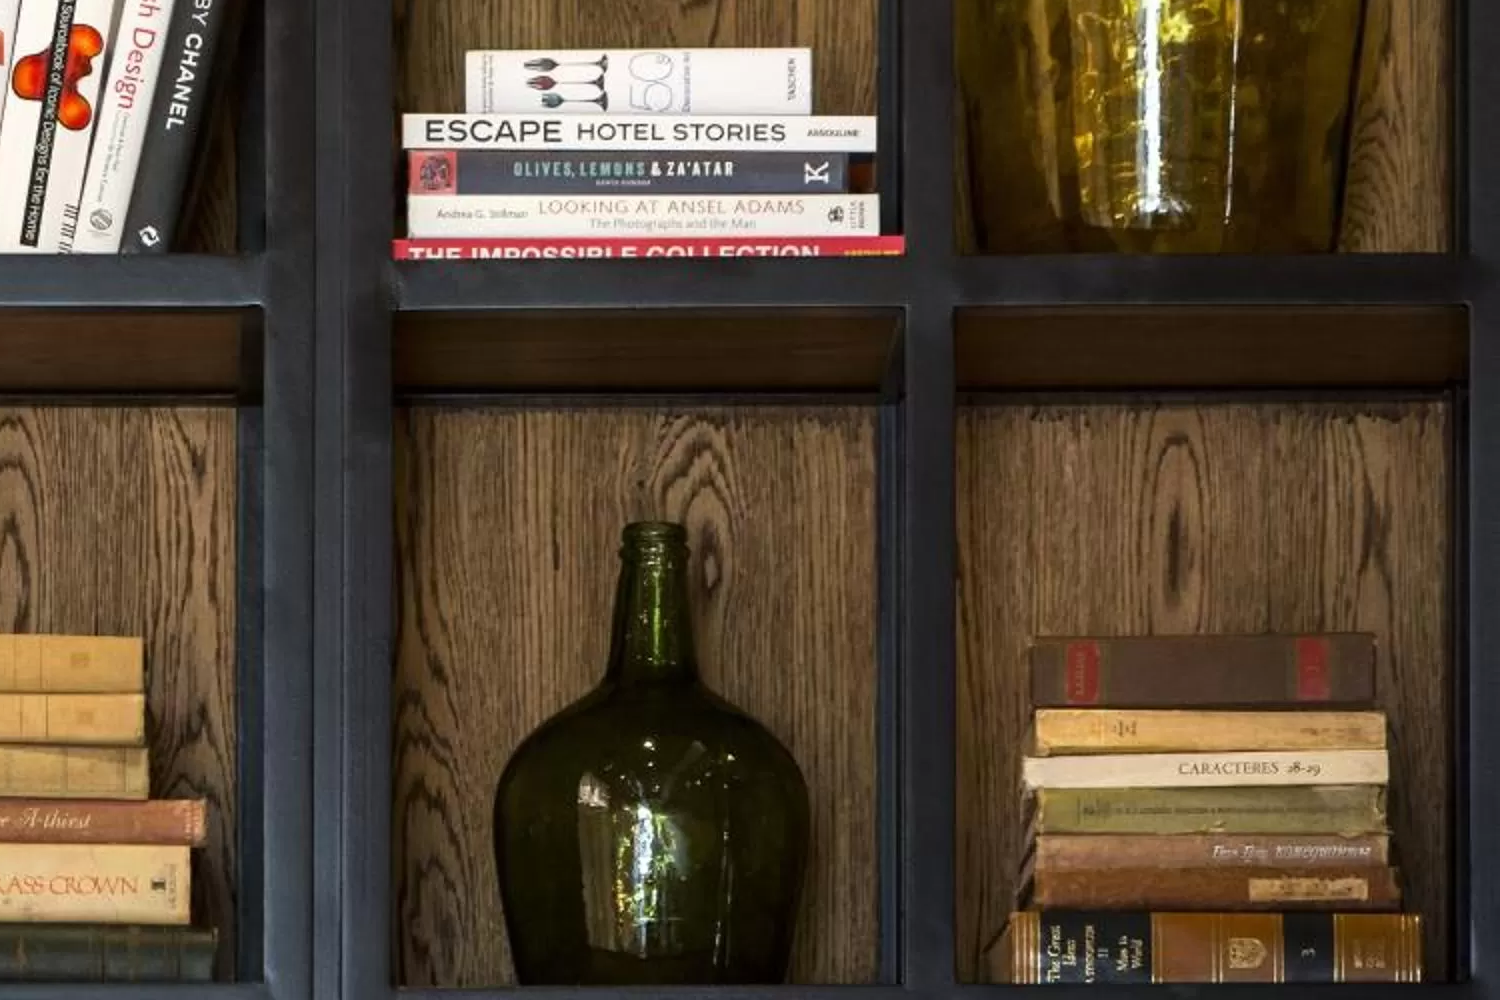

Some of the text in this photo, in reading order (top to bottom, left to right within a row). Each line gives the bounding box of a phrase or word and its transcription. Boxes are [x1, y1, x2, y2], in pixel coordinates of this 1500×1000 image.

[52, 5, 74, 71] Sourcebook
[114, 26, 157, 110] Design
[787, 57, 797, 101] TASCHEN
[165, 33, 203, 131] CHANEL
[425, 119, 786, 142] ESCAPE HOTEL STORIES
[35, 121, 55, 165] Designs
[513, 161, 734, 178] OLIVES, LEMONS & ZA'ATAR
[804, 161, 829, 184] K
[437, 207, 473, 219] Andrea
[538, 199, 805, 215] LOOKING AT ANSEL ADAMS
[590, 218, 757, 231] The Photographs and the Man
[1178, 761, 1321, 777] CARACTERES 28-29
[49, 875, 139, 896] CROWN
